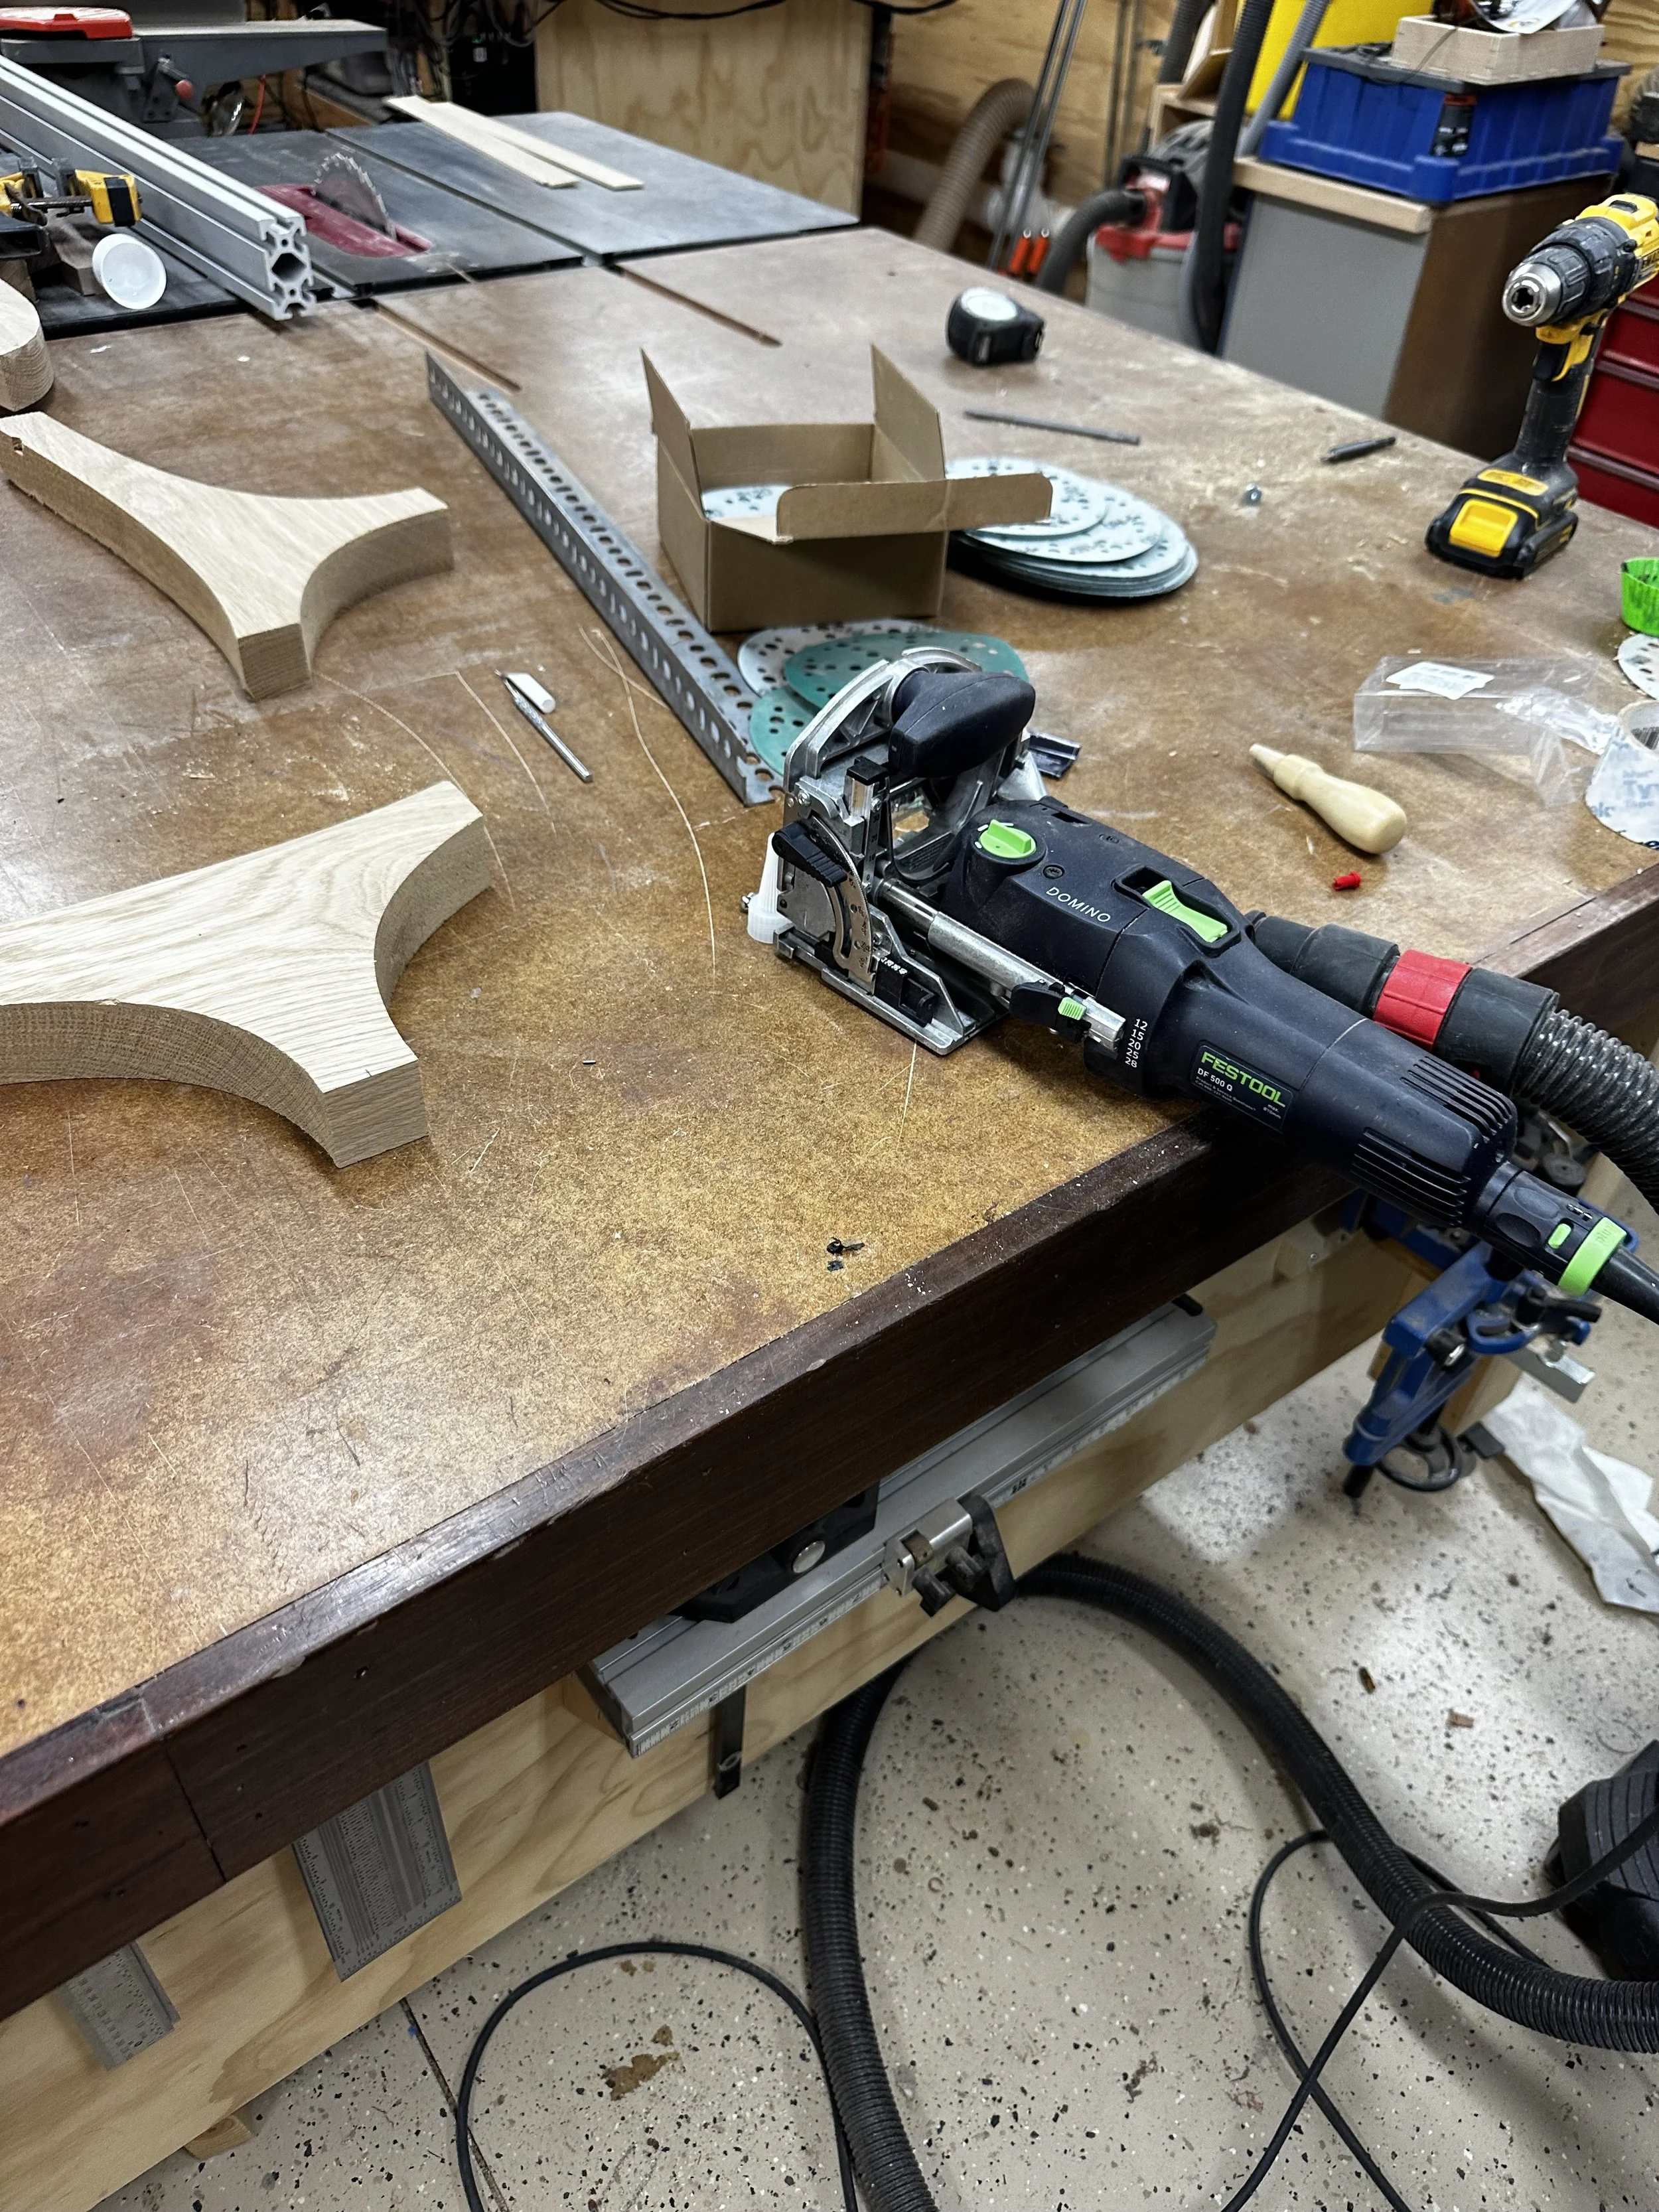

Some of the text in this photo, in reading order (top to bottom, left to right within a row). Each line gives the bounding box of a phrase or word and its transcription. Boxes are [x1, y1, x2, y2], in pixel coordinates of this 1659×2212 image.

[1046, 887, 1111, 922] DOMINO
[1134, 1018, 1148, 1031] 12
[1131, 1029, 1145, 1041] 15
[1128, 1038, 1141, 1050] 20
[1126, 1048, 1139, 1059] 25
[1125, 1057, 1137, 1068] 28
[1197, 1068, 1209, 1077] DF
[1210, 1074, 1225, 1087] 500
[1201, 1051, 1285, 1108] FESTOOL
